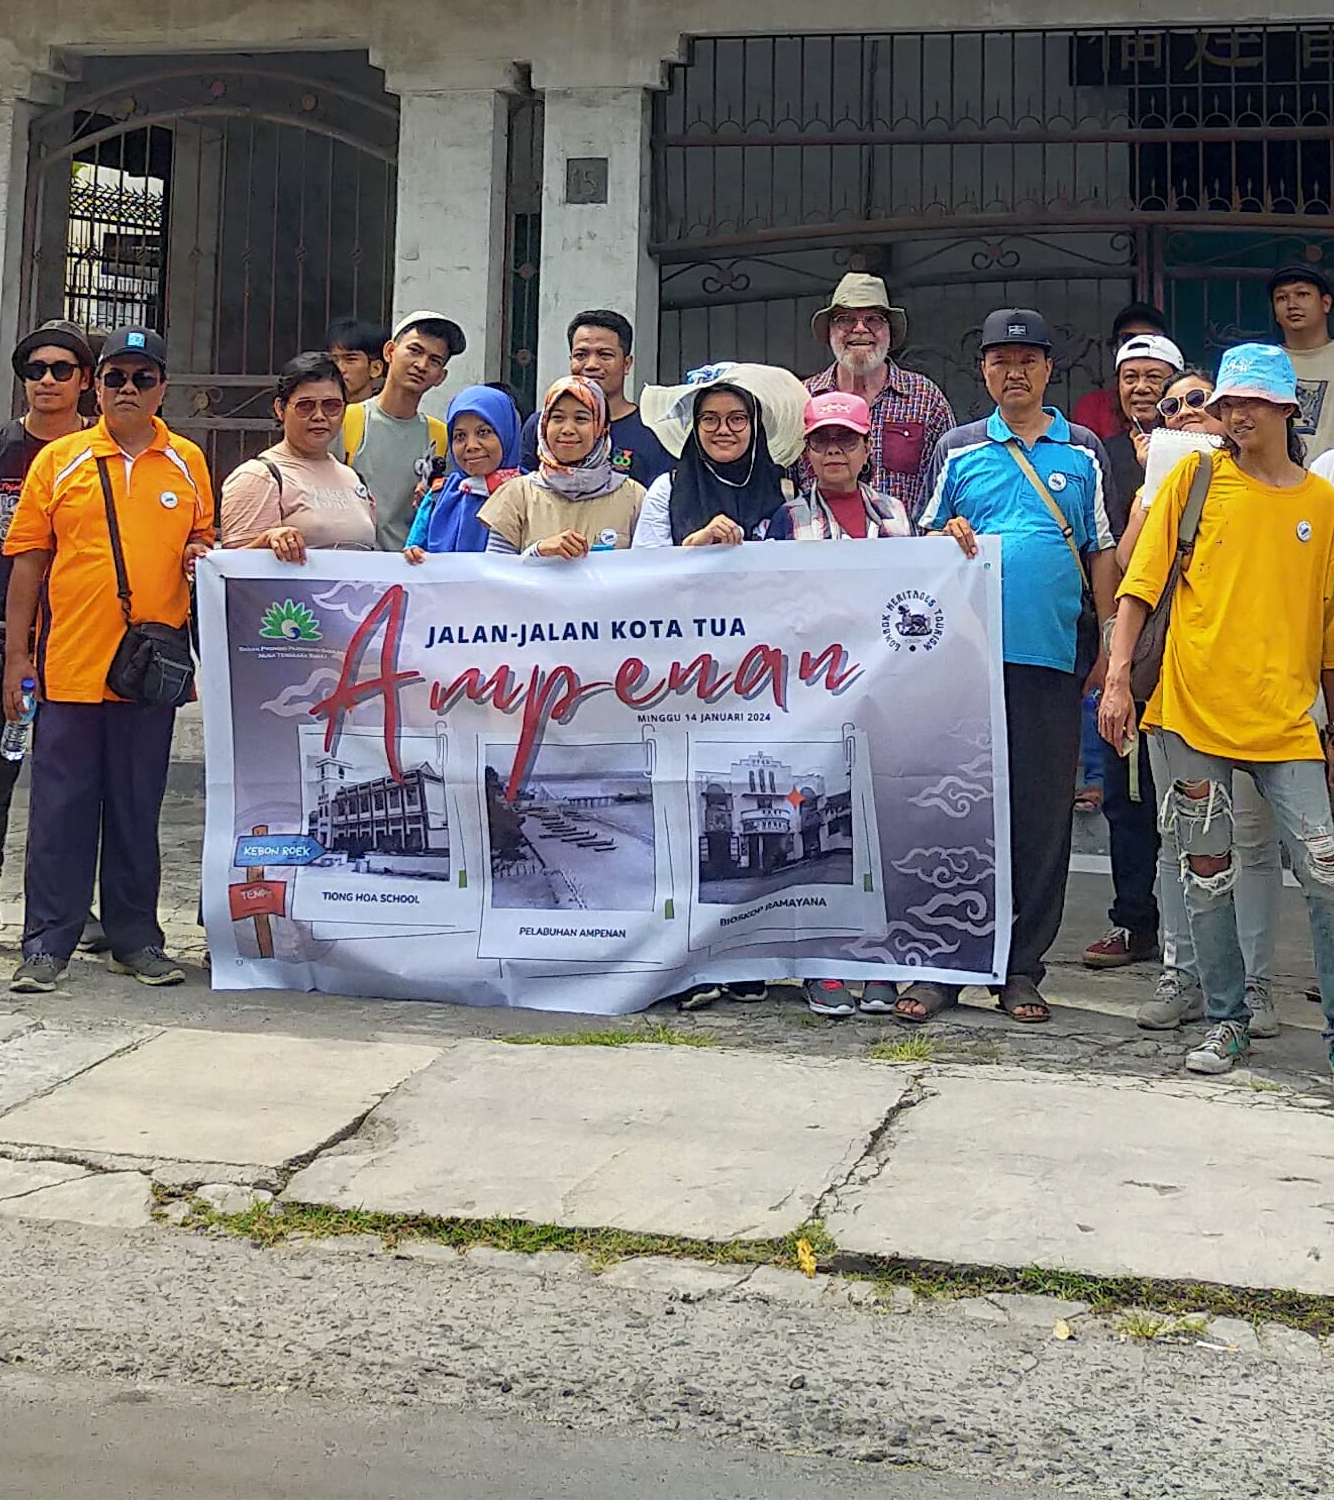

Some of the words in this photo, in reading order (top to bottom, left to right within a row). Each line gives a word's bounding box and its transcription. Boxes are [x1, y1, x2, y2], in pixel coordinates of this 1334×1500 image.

[886, 589, 936, 612] HERITAGES
[425, 621, 599, 648] JALAN-JALAN
[611, 620, 683, 639] KOTA
[693, 618, 746, 637] TUA
[309, 584, 863, 801] Ampenan
[637, 713, 681, 723] MINGGU
[685, 713, 697, 722] 14
[699, 712, 744, 723] JANUARI
[747, 712, 771, 722] 2024
[244, 845, 279, 856] KEBON
[281, 846, 311, 856] ROEK
[322, 891, 353, 901] TIONG
[355, 892, 378, 902] HOA
[380, 893, 419, 904] SCHOOL
[719, 907, 763, 927] BIOSKOP
[765, 897, 827, 911] RAMAYANA
[519, 926, 577, 937] PELABUHAN
[579, 928, 626, 938] AMPENAN
